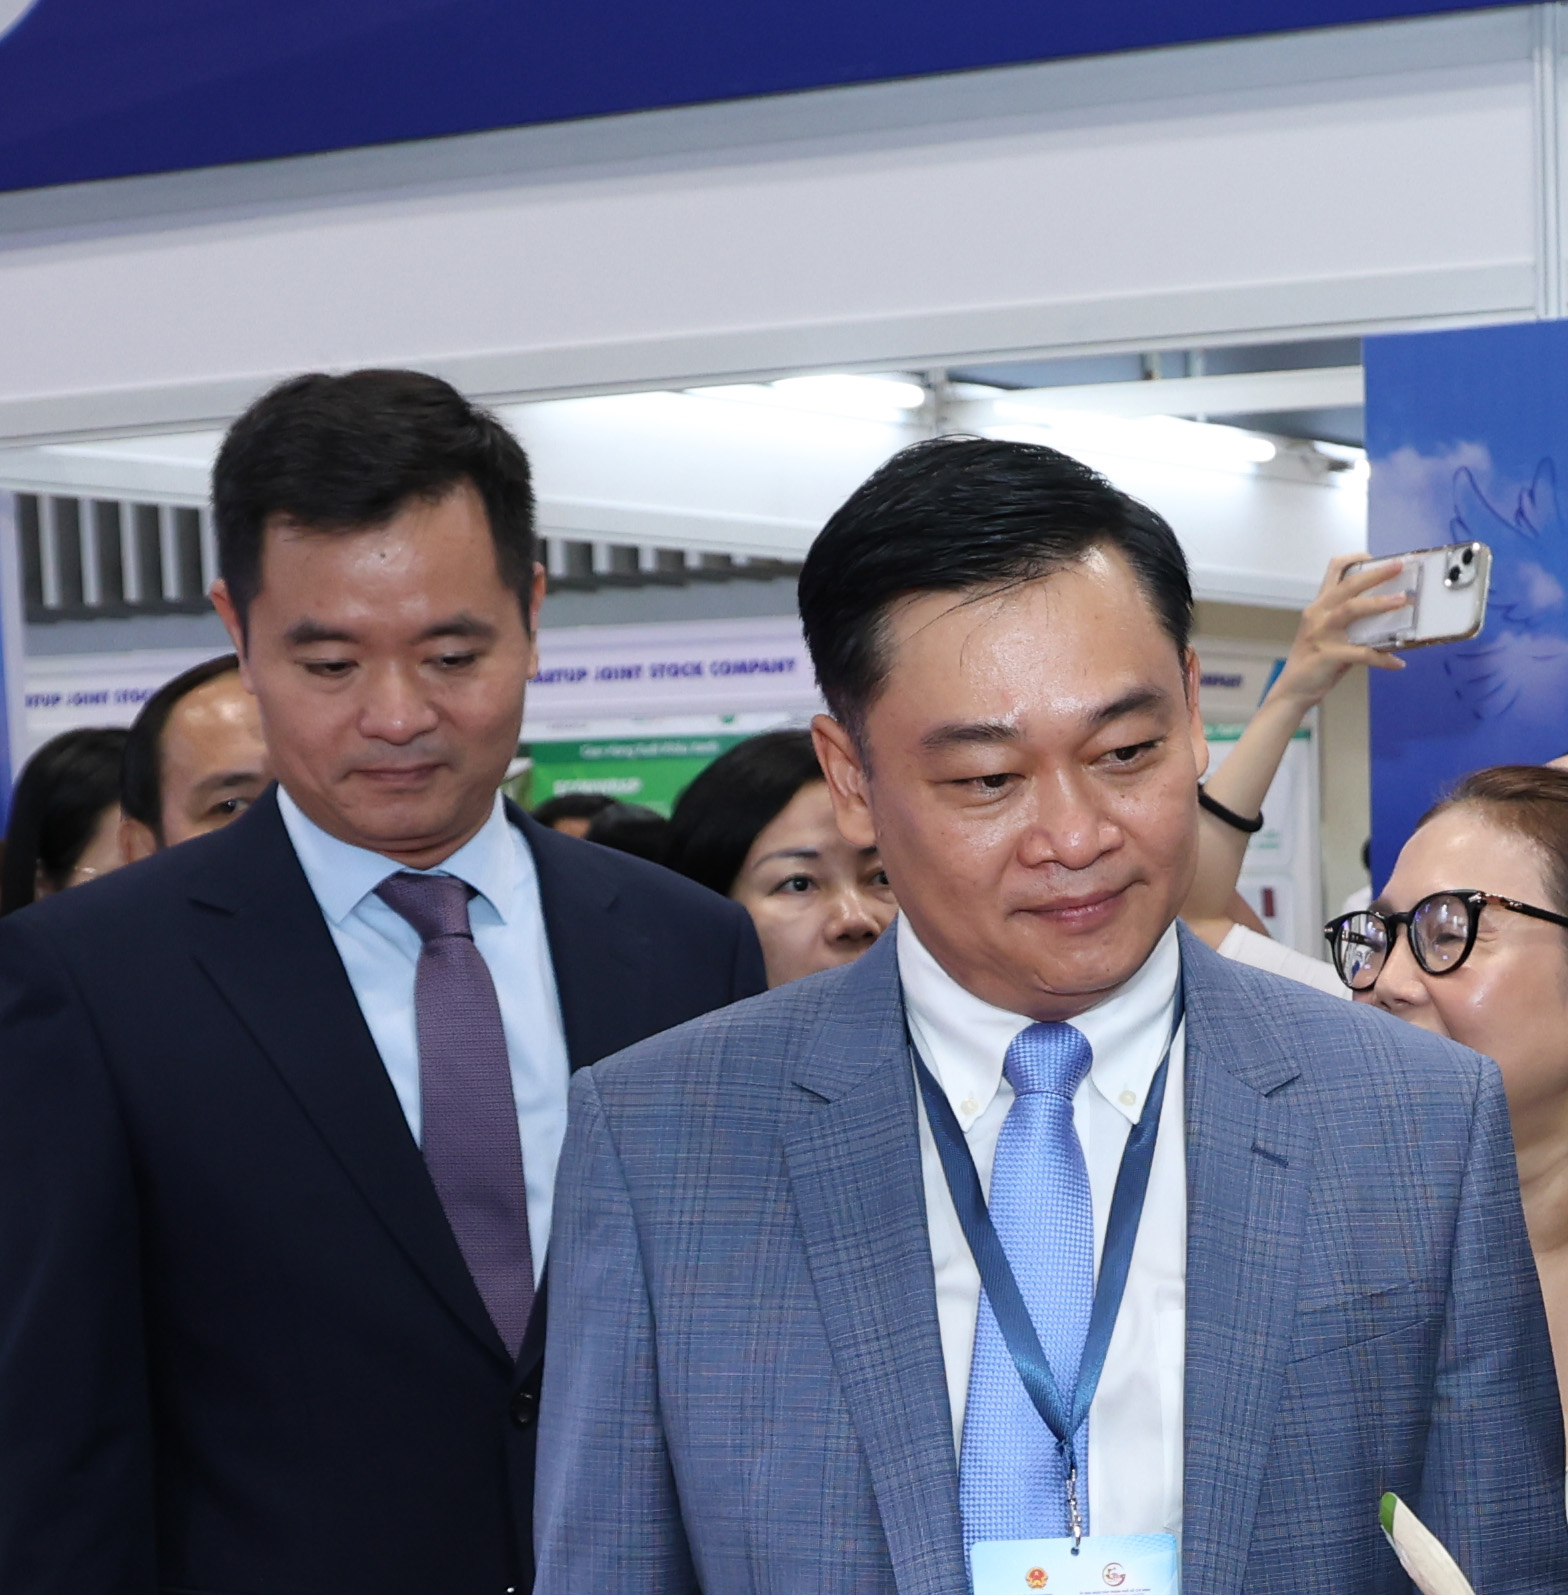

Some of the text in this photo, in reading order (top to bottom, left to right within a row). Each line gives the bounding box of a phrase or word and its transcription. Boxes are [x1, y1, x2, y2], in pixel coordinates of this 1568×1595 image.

[530, 666, 587, 684] ARTUP
[650, 661, 702, 679] STOCK
[710, 657, 796, 677] COMPANY
[114, 687, 153, 704] STOC
